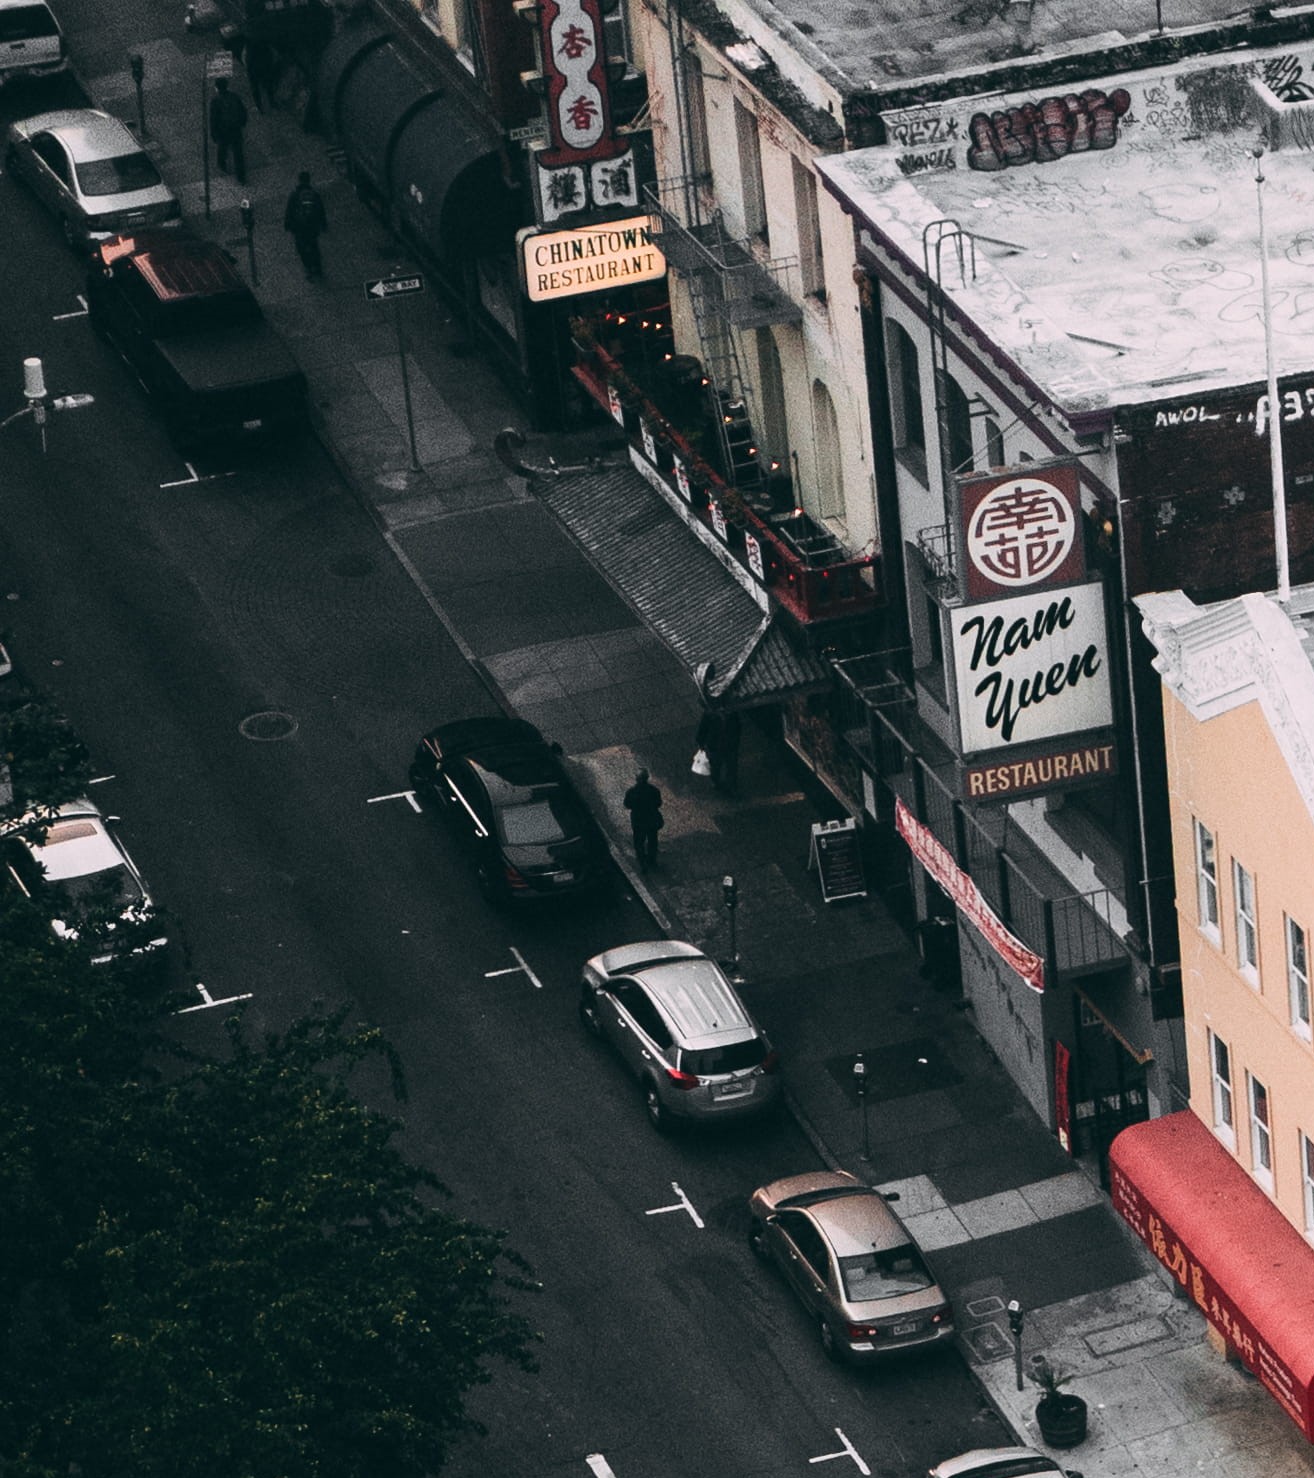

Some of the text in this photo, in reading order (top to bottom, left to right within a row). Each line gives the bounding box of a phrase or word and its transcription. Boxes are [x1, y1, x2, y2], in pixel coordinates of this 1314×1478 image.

[535, 226, 651, 267] CHINATOWN
[537, 253, 655, 292] RESTAURANT
[961, 596, 1075, 671] Nam
[974, 644, 1101, 742] Yuen
[969, 745, 1113, 796] RESTAURANT
